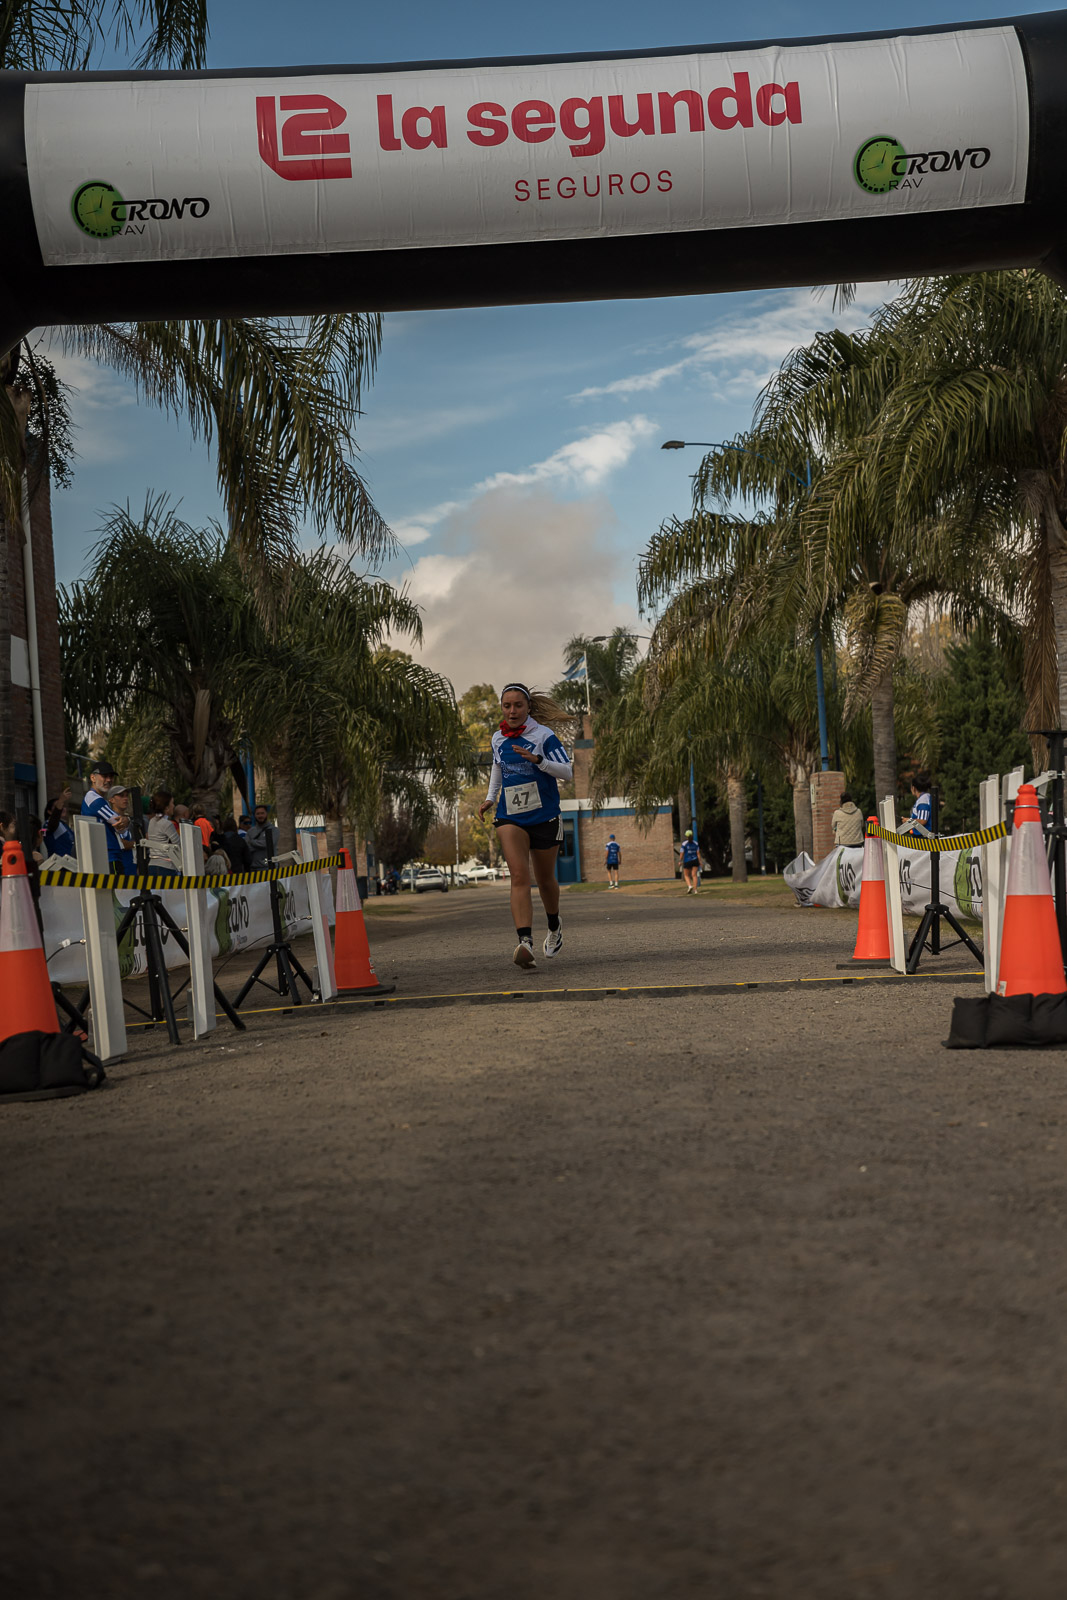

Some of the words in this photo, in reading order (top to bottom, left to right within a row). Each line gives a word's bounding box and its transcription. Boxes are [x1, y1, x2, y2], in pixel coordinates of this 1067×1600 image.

[377, 94, 448, 151] la
[466, 71, 803, 158] segunda
[891, 147, 991, 176] CRONO
[514, 170, 674, 202] SEGUROS
[888, 178, 924, 191] RAV
[111, 197, 210, 222] CRONO
[111, 224, 146, 236] RAV
[512, 791, 530, 807] 47
